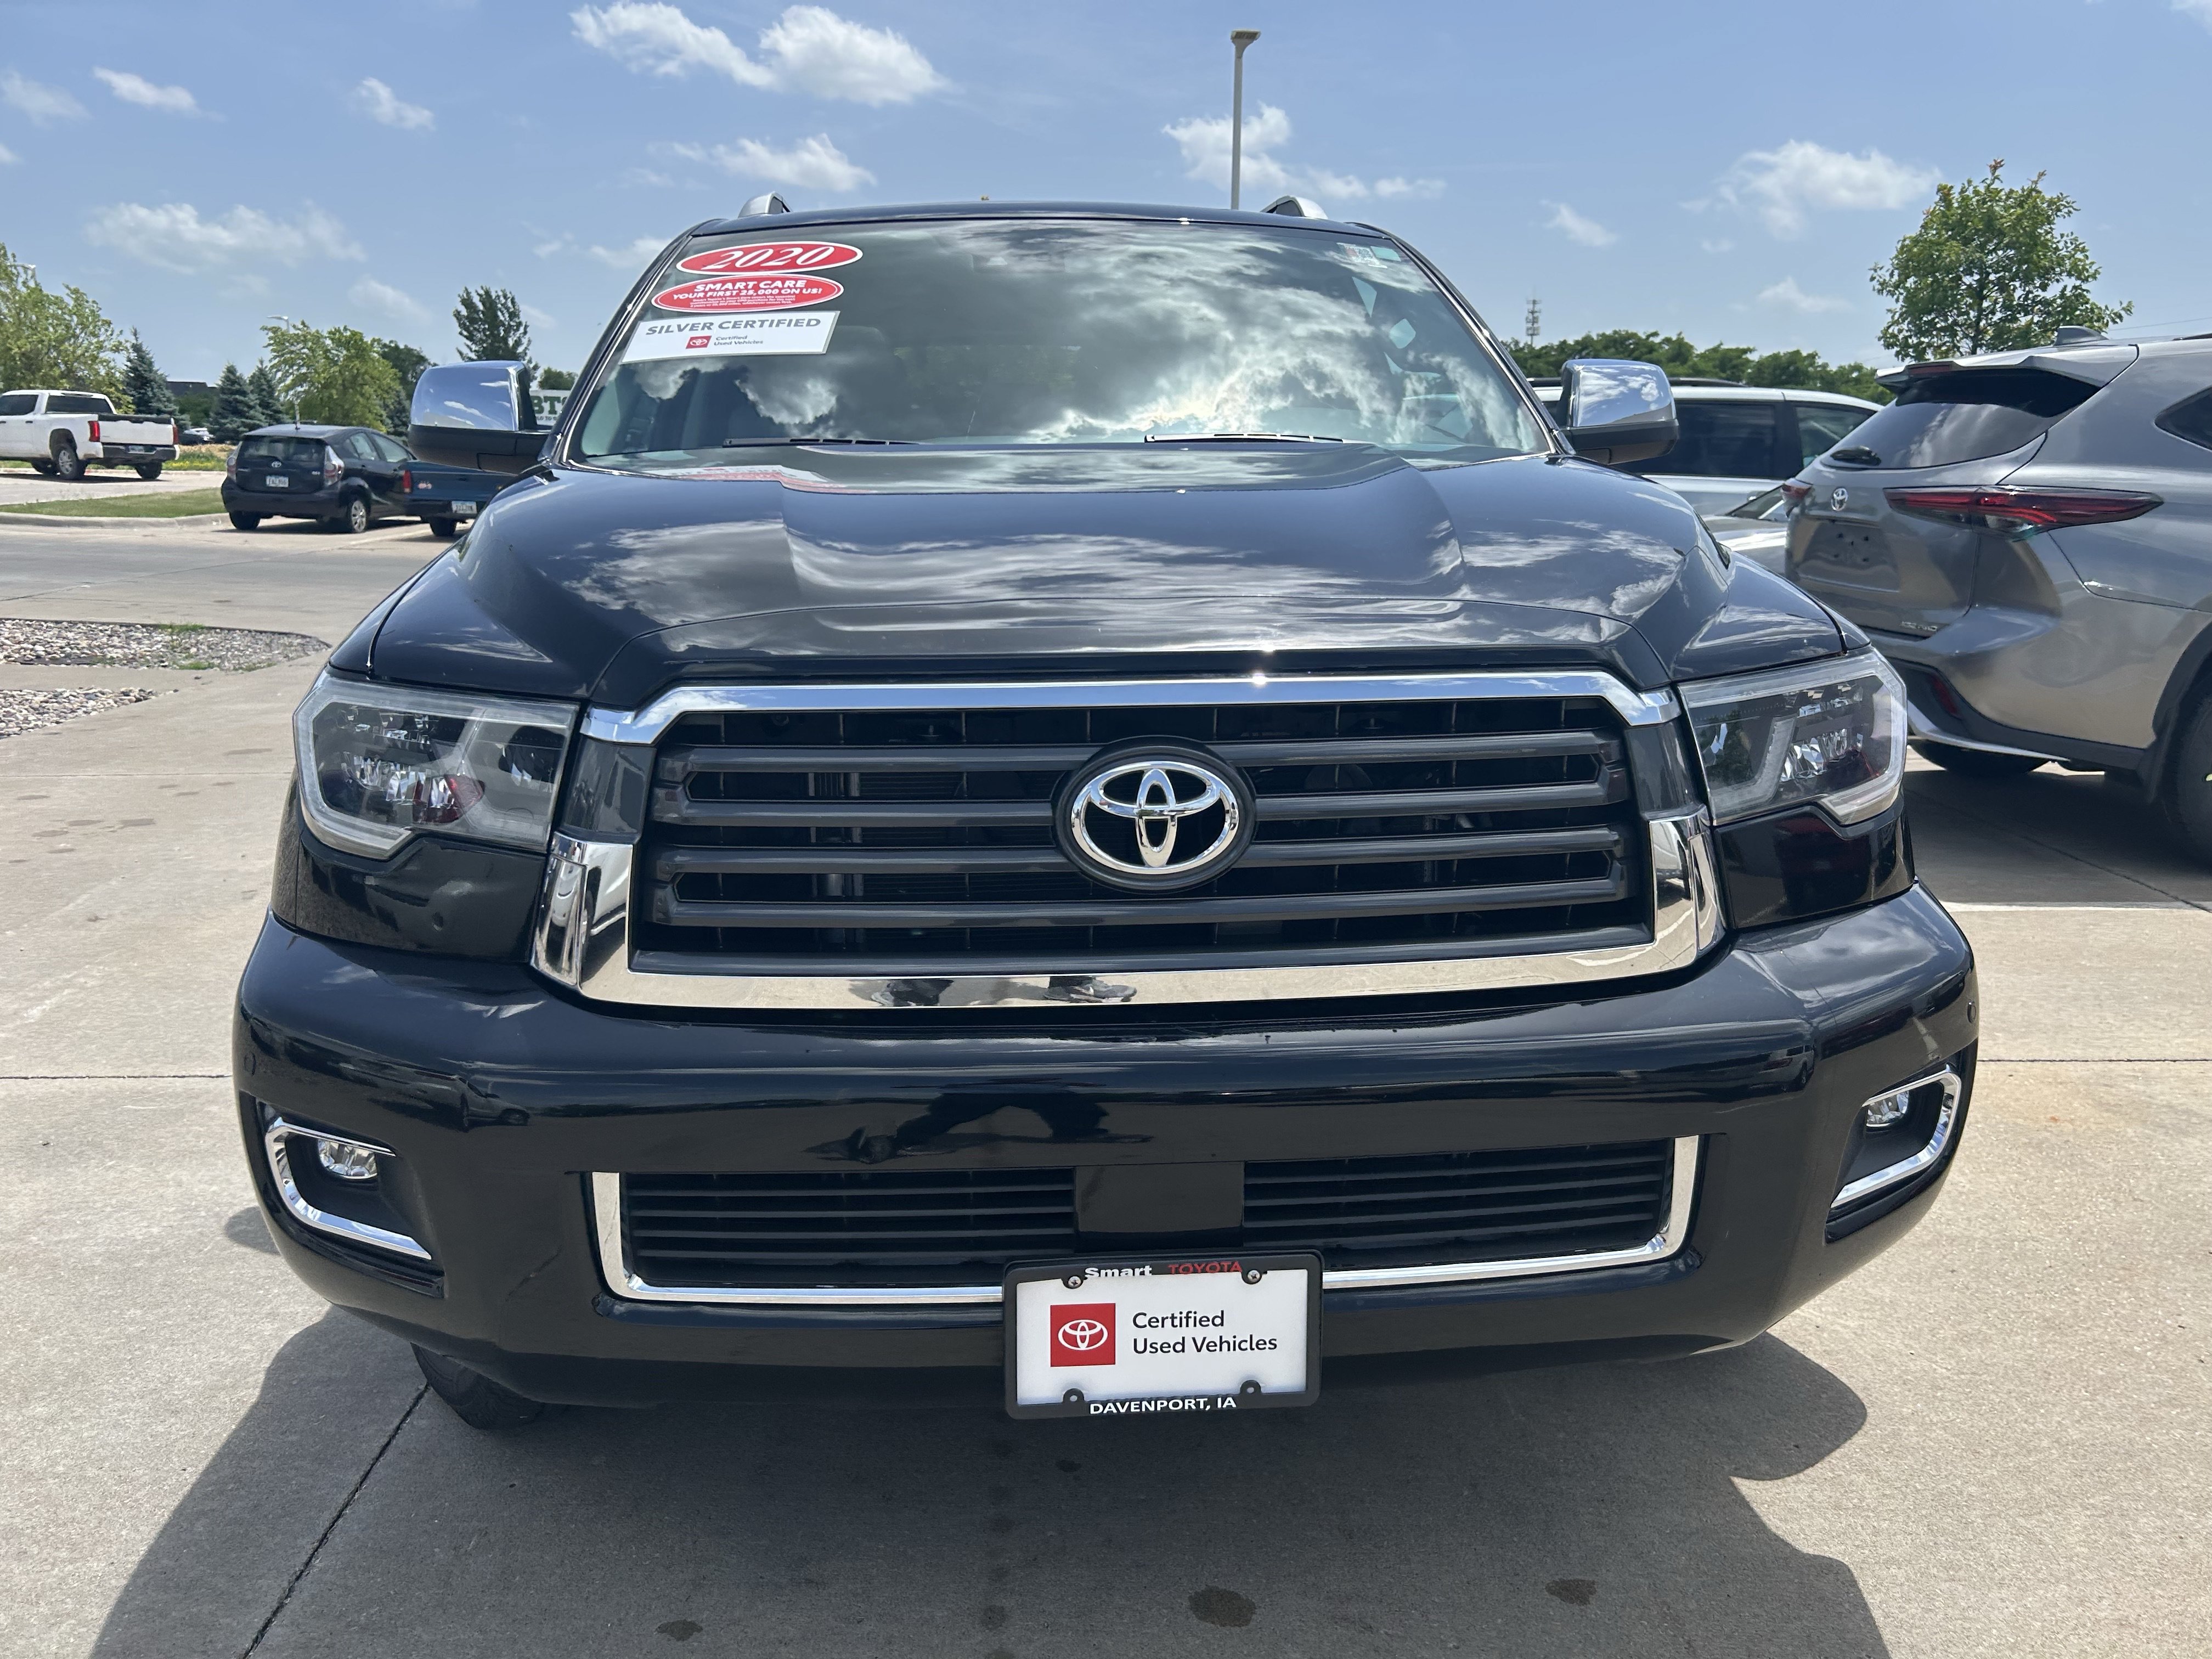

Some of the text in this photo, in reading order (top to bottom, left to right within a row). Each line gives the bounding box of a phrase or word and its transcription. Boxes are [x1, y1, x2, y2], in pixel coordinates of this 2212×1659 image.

[701, 246, 834, 270] 2020
[694, 280, 807, 292] SMART CARE
[646, 318, 821, 335] SILVER CERTIFIED
[1084, 1261, 1242, 1278] Smart TOYOTA
[1132, 1310, 1224, 1328] Certified
[1133, 1334, 1277, 1353] Used Vehicles
[1090, 1397, 1237, 1414] DAVENPORT, IA
